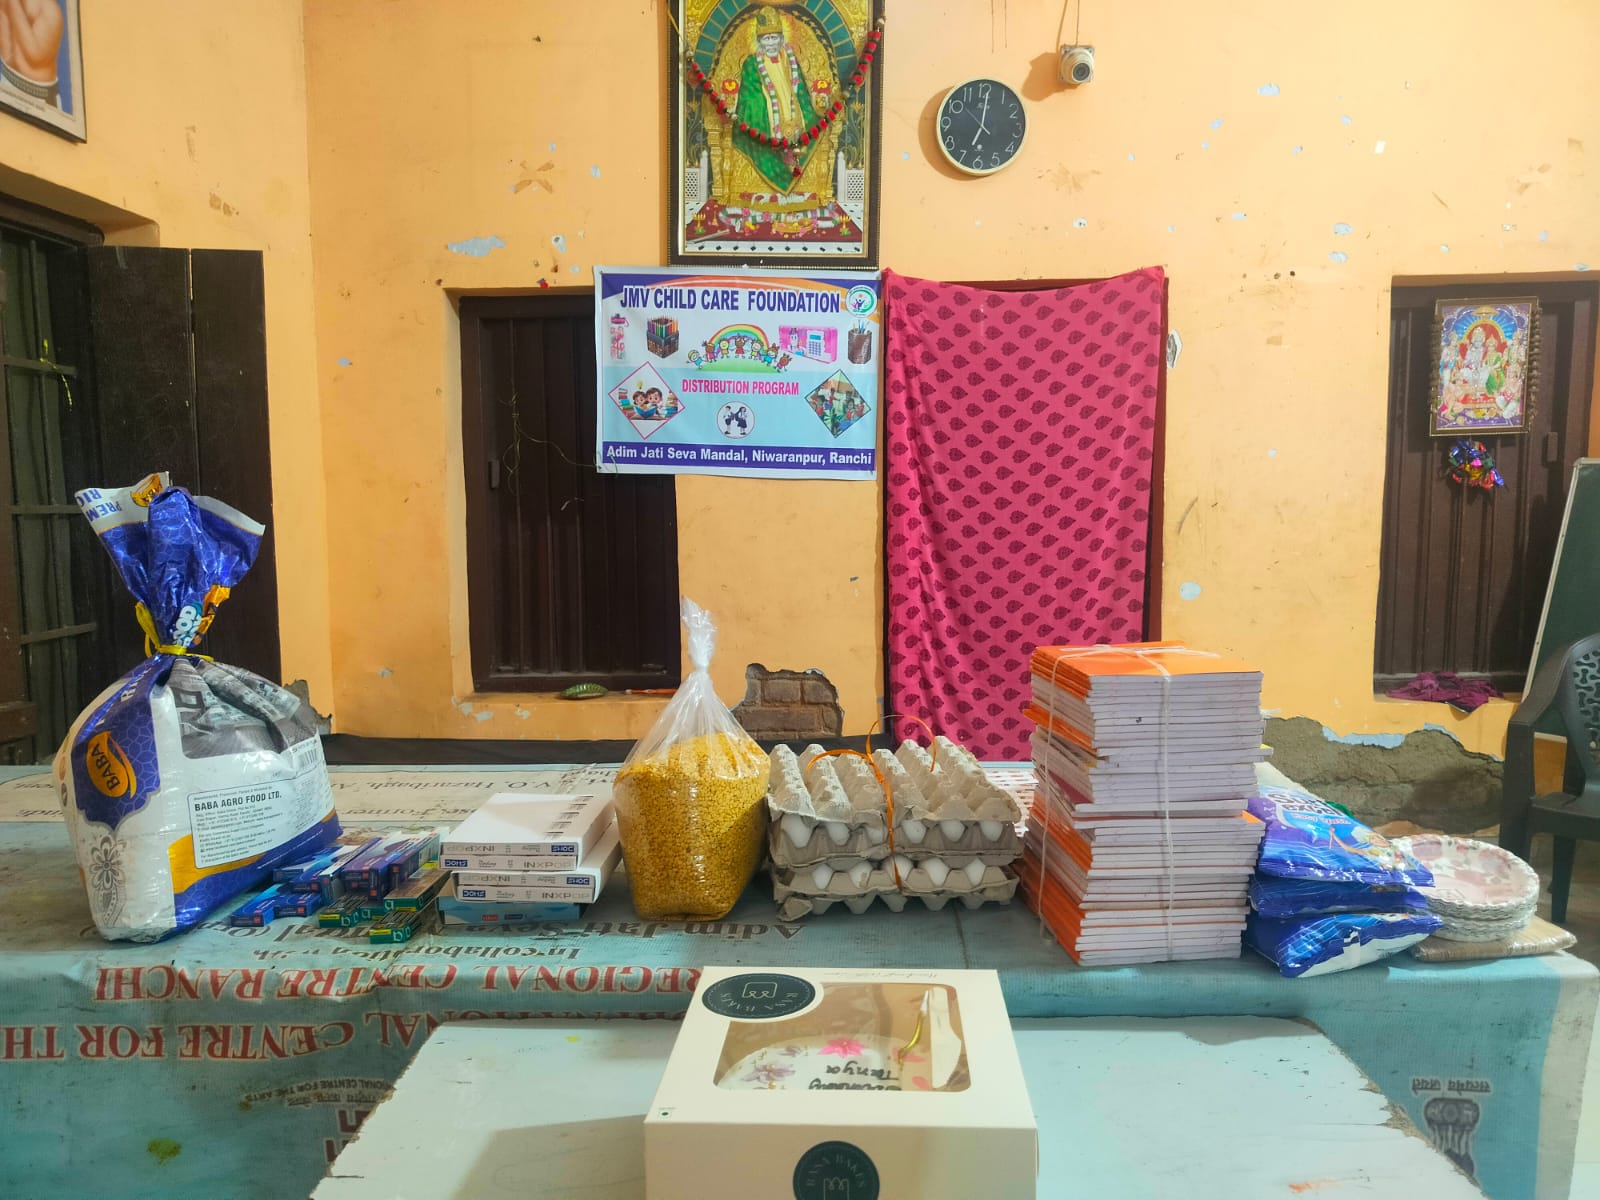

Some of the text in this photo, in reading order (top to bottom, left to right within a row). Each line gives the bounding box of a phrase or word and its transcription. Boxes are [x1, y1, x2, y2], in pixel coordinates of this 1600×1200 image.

[963, 87, 972, 102] 11
[978, 83, 991, 99] 12
[948, 99, 963, 114] 10
[1008, 103, 1019, 119] 2
[941, 116, 951, 132] 9
[1012, 122, 1023, 138] 3
[944, 136, 955, 150] 8
[1005, 141, 1014, 155] 4
[960, 149, 967, 163] 7
[972, 155, 983, 170] 6
[990, 152, 1000, 168] 5
[620, 286, 840, 313] JMV CHILD CARE FOUNDATION
[681, 379, 799, 396] DISTRIBUTION PROGRAM
[606, 445, 872, 466] Adim Jati Seva Mandal, Niwaranpur, Ranchi
[91, 743, 120, 791] BABA
[194, 800, 219, 812] BABA
[221, 797, 244, 808] AGRO
[245, 793, 266, 804] FOOD
[268, 790, 282, 800] LTD.
[579, 922, 668, 939] Jati
[683, 922, 806, 940] Adim
[544, 947, 581, 960] In
[96, 965, 702, 1001] REGIONAL CENTRE RANCHI
[79, 1024, 165, 1059] FOR
[178, 1022, 355, 1059] CENTRE
